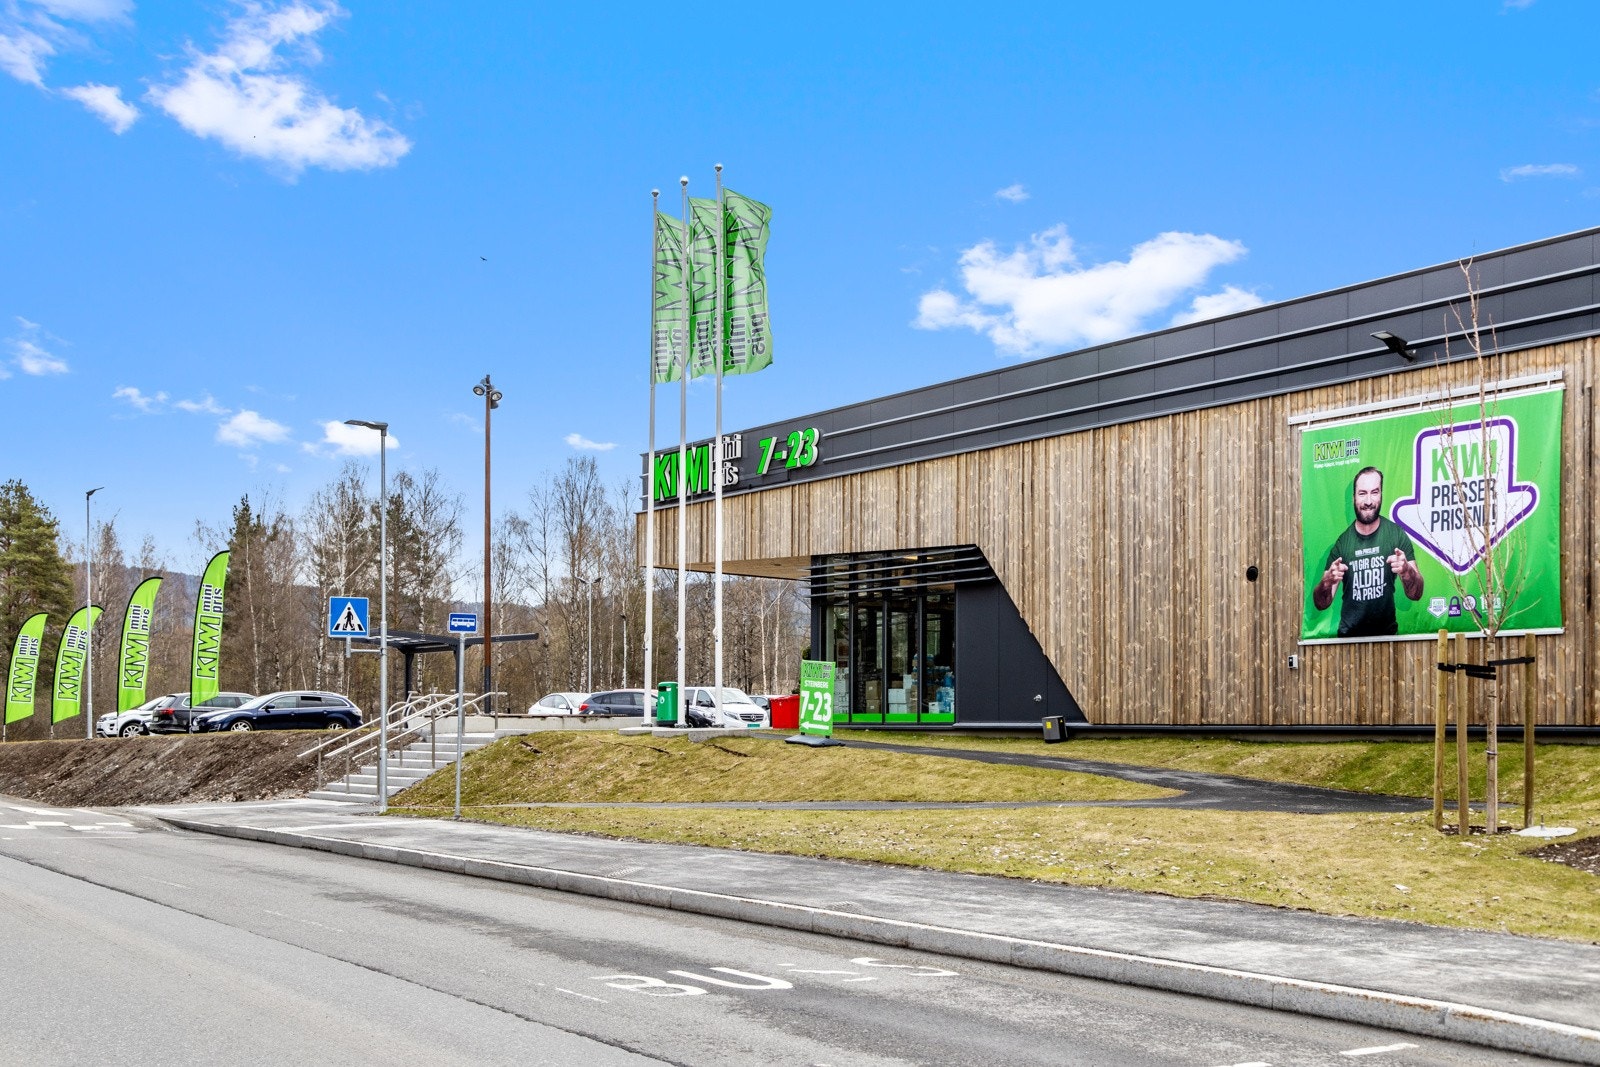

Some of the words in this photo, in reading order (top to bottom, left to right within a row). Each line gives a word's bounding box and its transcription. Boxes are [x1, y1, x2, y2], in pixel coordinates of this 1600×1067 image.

[756, 427, 820, 475] 7-23
[1314, 440, 1345, 462] KIWI
[1346, 437, 1360, 447] mini
[1346, 447, 1359, 457] pris
[653, 445, 710, 501] KIWI
[1432, 440, 1498, 482] KIWI
[711, 462, 739, 493] pis
[1432, 478, 1497, 507] PRESSER
[1359, 558, 1370, 570] GIR
[1371, 555, 1384, 568] OSS
[1353, 567, 1385, 590] ALDRI
[202, 584, 213, 612] mini
[212, 588, 224, 613] pris
[129, 604, 141, 631] mini
[17, 635, 29, 655] mini
[29, 638, 40, 656] pris
[66, 625, 79, 648] mini
[77, 630, 89, 651] pris
[196, 614, 222, 679] KIWI
[123, 632, 151, 690] KIWI
[10, 657, 36, 703] KIWI
[57, 649, 84, 703] KIWI
[800, 690, 832, 723] 7-23
